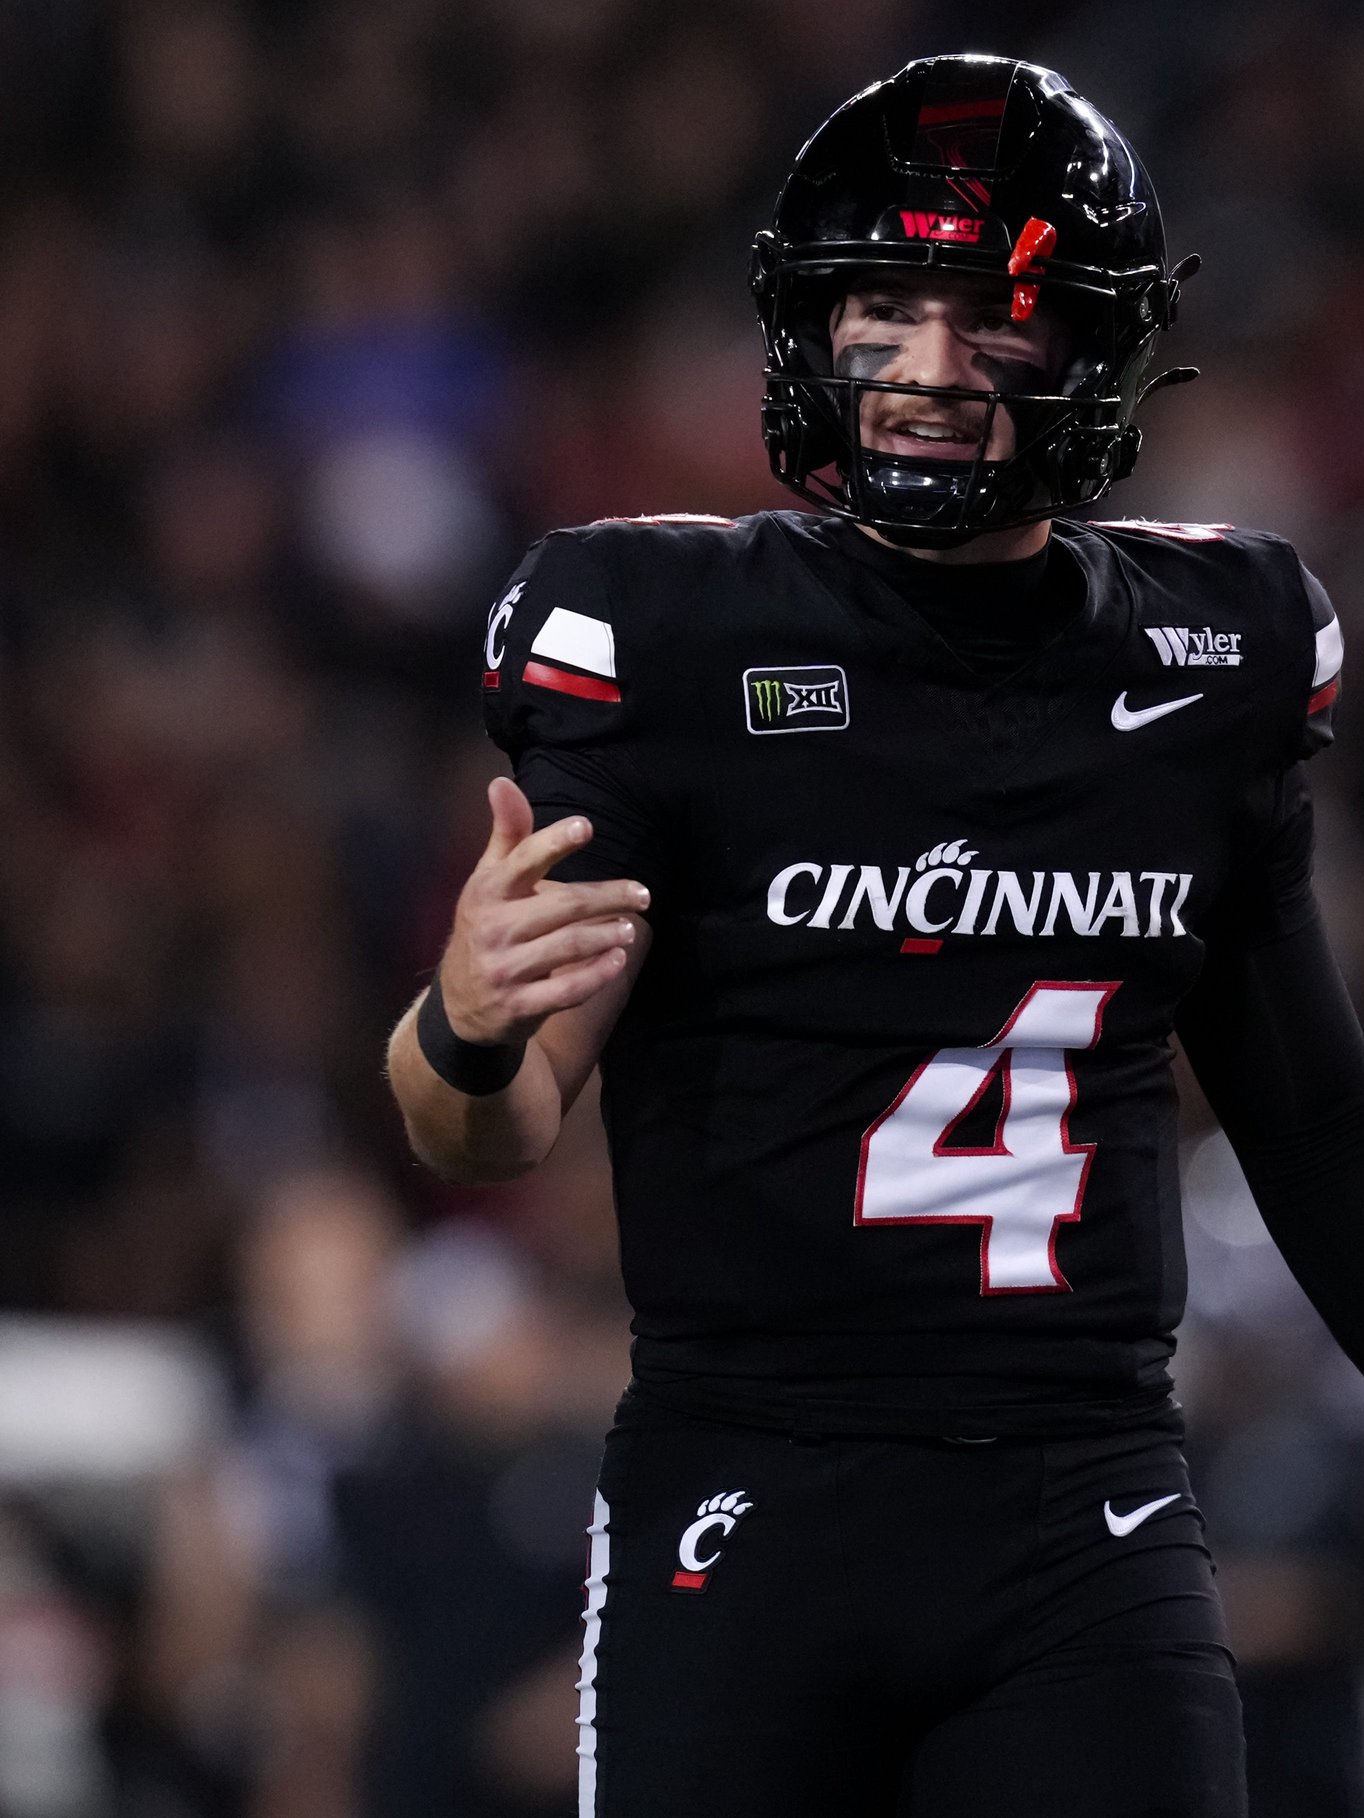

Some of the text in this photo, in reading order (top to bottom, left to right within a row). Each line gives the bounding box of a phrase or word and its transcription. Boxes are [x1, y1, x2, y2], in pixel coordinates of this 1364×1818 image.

[1144, 627, 1241, 666] Wyler
[767, 862, 1194, 938] CINCINNATI
[853, 980, 1124, 1297] 4
